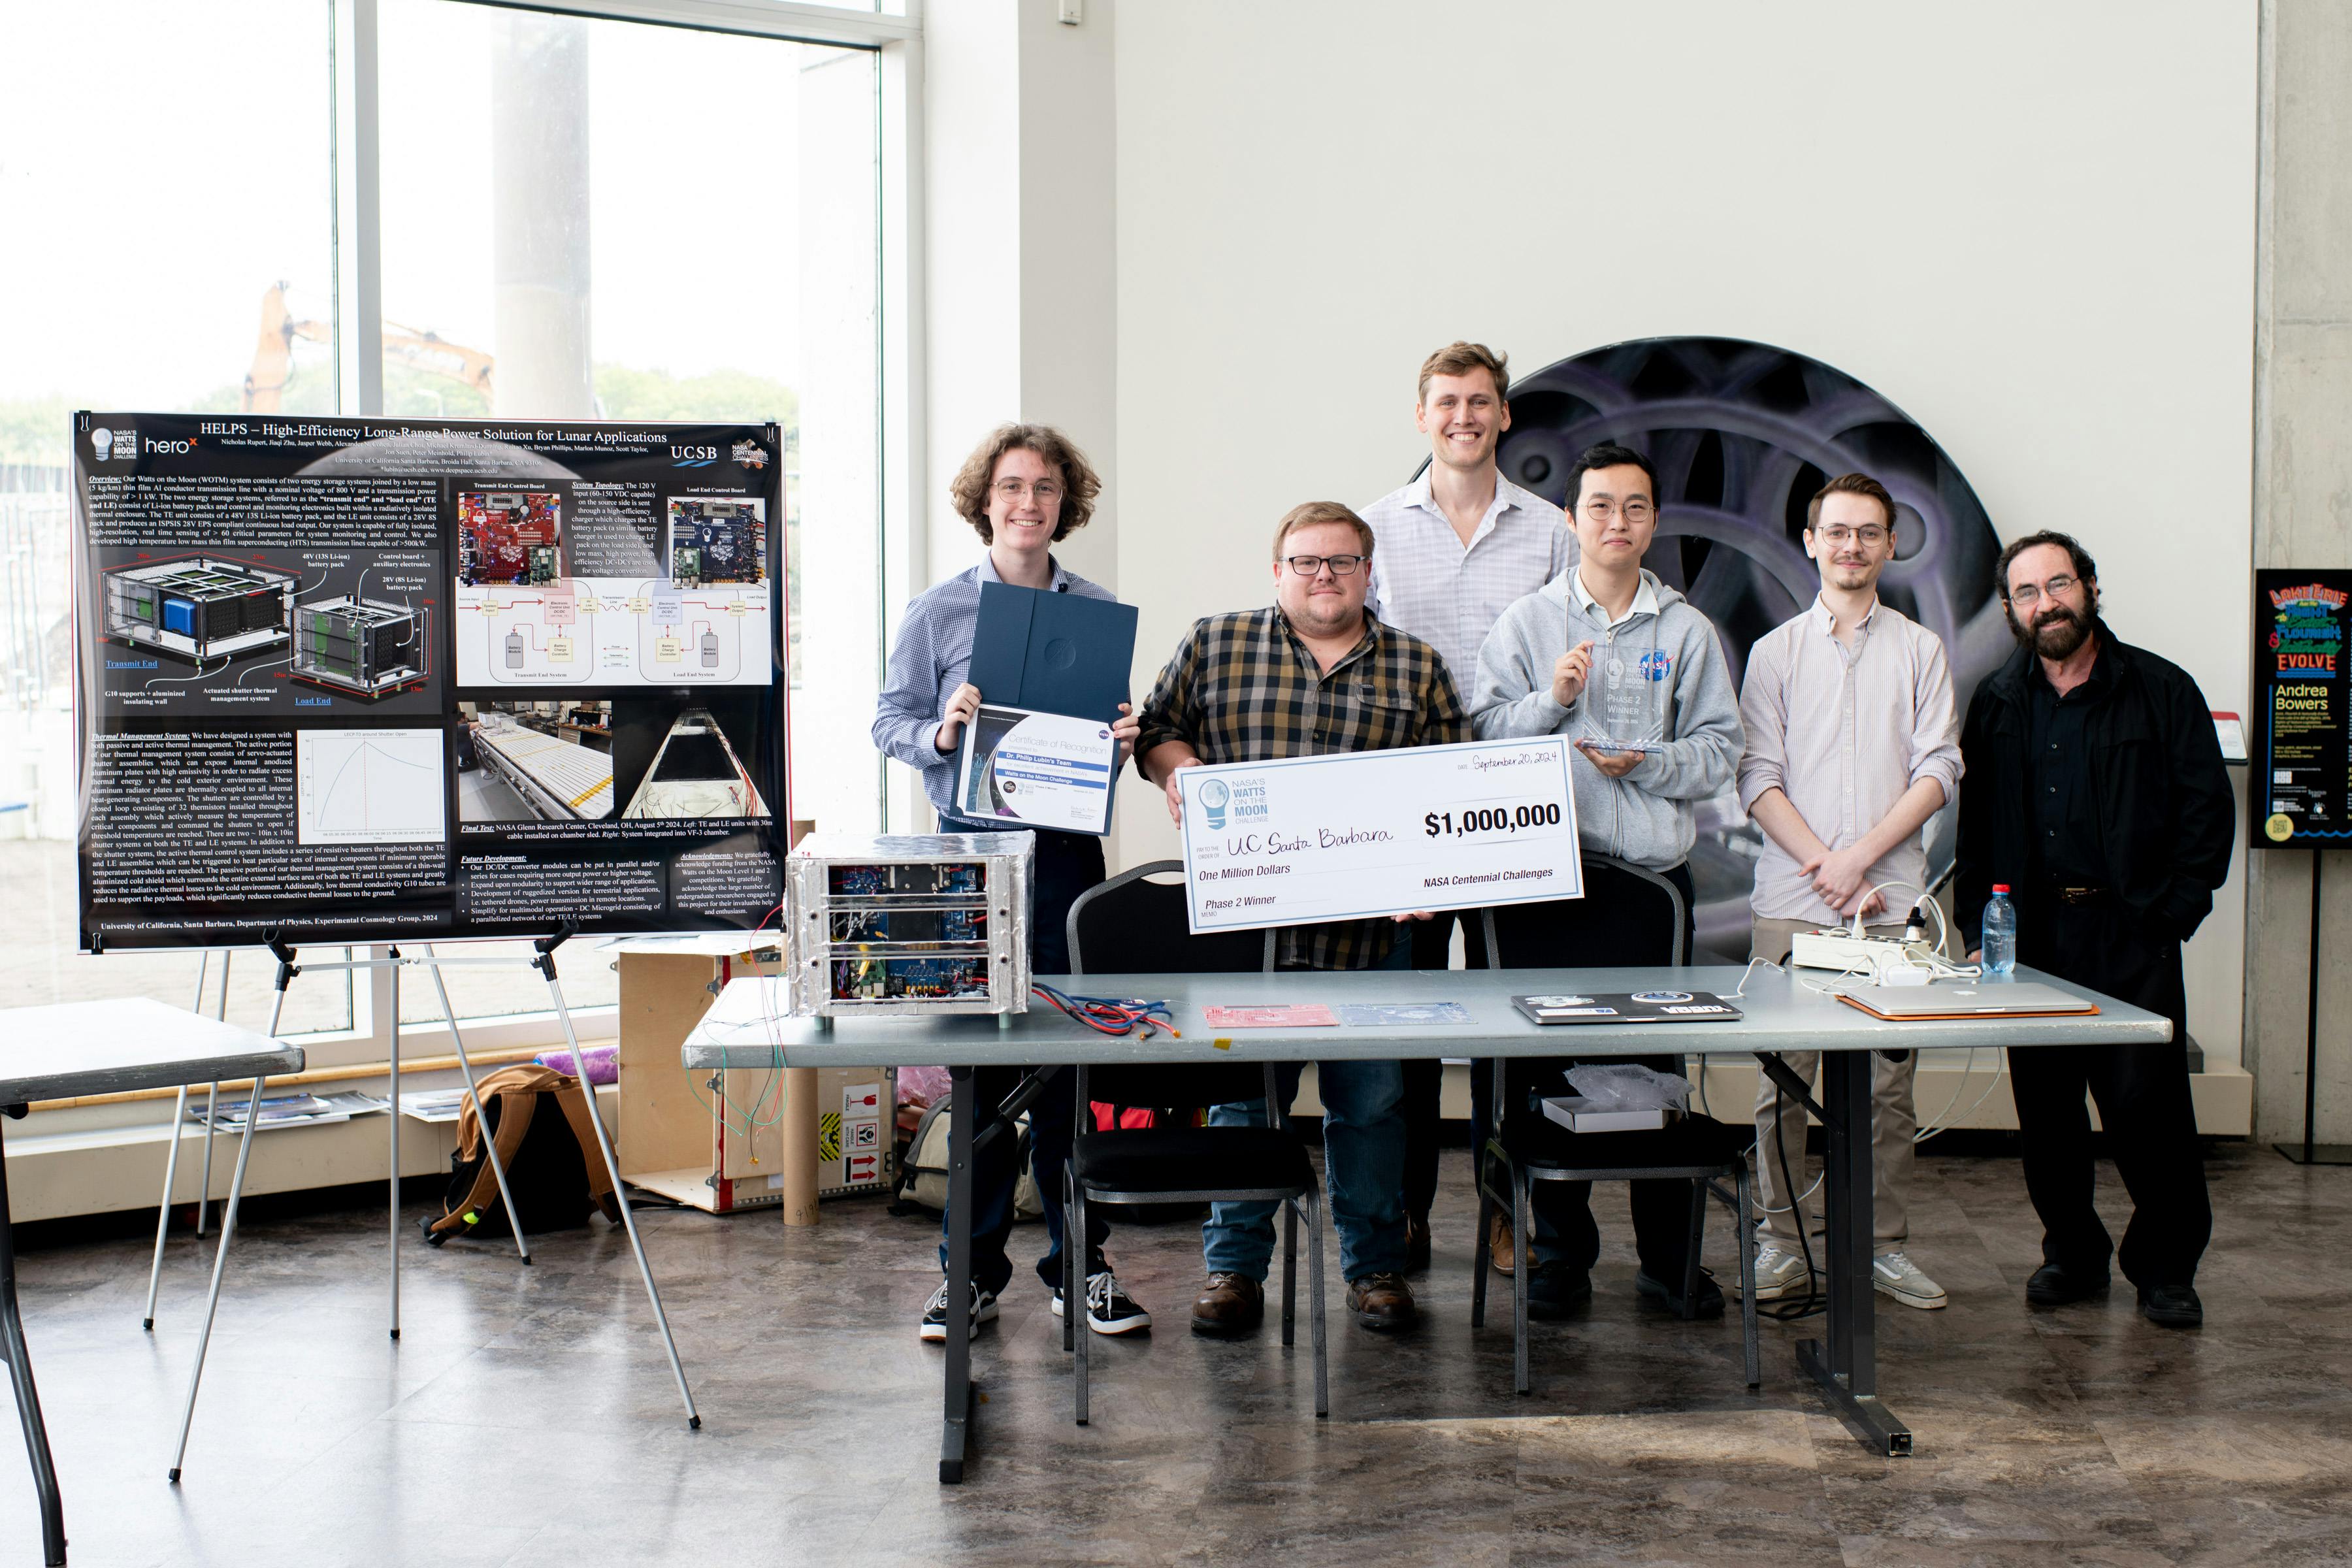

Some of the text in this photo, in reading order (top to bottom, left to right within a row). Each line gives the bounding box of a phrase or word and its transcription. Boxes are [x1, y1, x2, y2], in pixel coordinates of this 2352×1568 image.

[201, 423, 248, 434] HELPS
[263, 424, 361, 440] High-Efficiency
[364, 427, 438, 440] Long-Range
[442, 427, 480, 439] Power
[482, 428, 533, 440] Solution
[536, 430, 554, 440] for
[557, 431, 592, 441] Lunar
[594, 431, 667, 444] Applications
[671, 446, 717, 459] UCSB
[595, 482, 624, 490] Topology:
[2268, 583, 2349, 607] LAKE ERIE
[106, 660, 158, 669] Transmit End
[2277, 654, 2336, 671] EVOLVE
[2276, 683, 2328, 697] Andrea
[295, 696, 332, 706] Load End
[2276, 697, 2328, 710] Bowers
[120, 733, 163, 742] Management
[1009, 734, 1049, 747] Certificate
[1060, 741, 1107, 754] Recognition
[1016, 753, 1033, 762] Philip
[1472, 751, 1557, 772] September 20, 2024
[1232, 778, 1266, 788] NASA'S
[1233, 787, 1266, 798] WATTS
[1234, 804, 1268, 817] MOON
[1235, 815, 1269, 825] CHALLENGE
[1425, 802, 1561, 838] $1,000,000
[1227, 826, 1394, 856] UC Santa Barbara
[1199, 864, 1291, 881] One Million Dollars
[1424, 868, 1554, 888] NASA Centennial Challenges
[1205, 895, 1277, 910] Phase 2 Winner
[315, 917, 359, 926] Experimental
[823, 1117, 837, 1132] HEAVY
[822, 1143, 836, 1158] HEAVY
